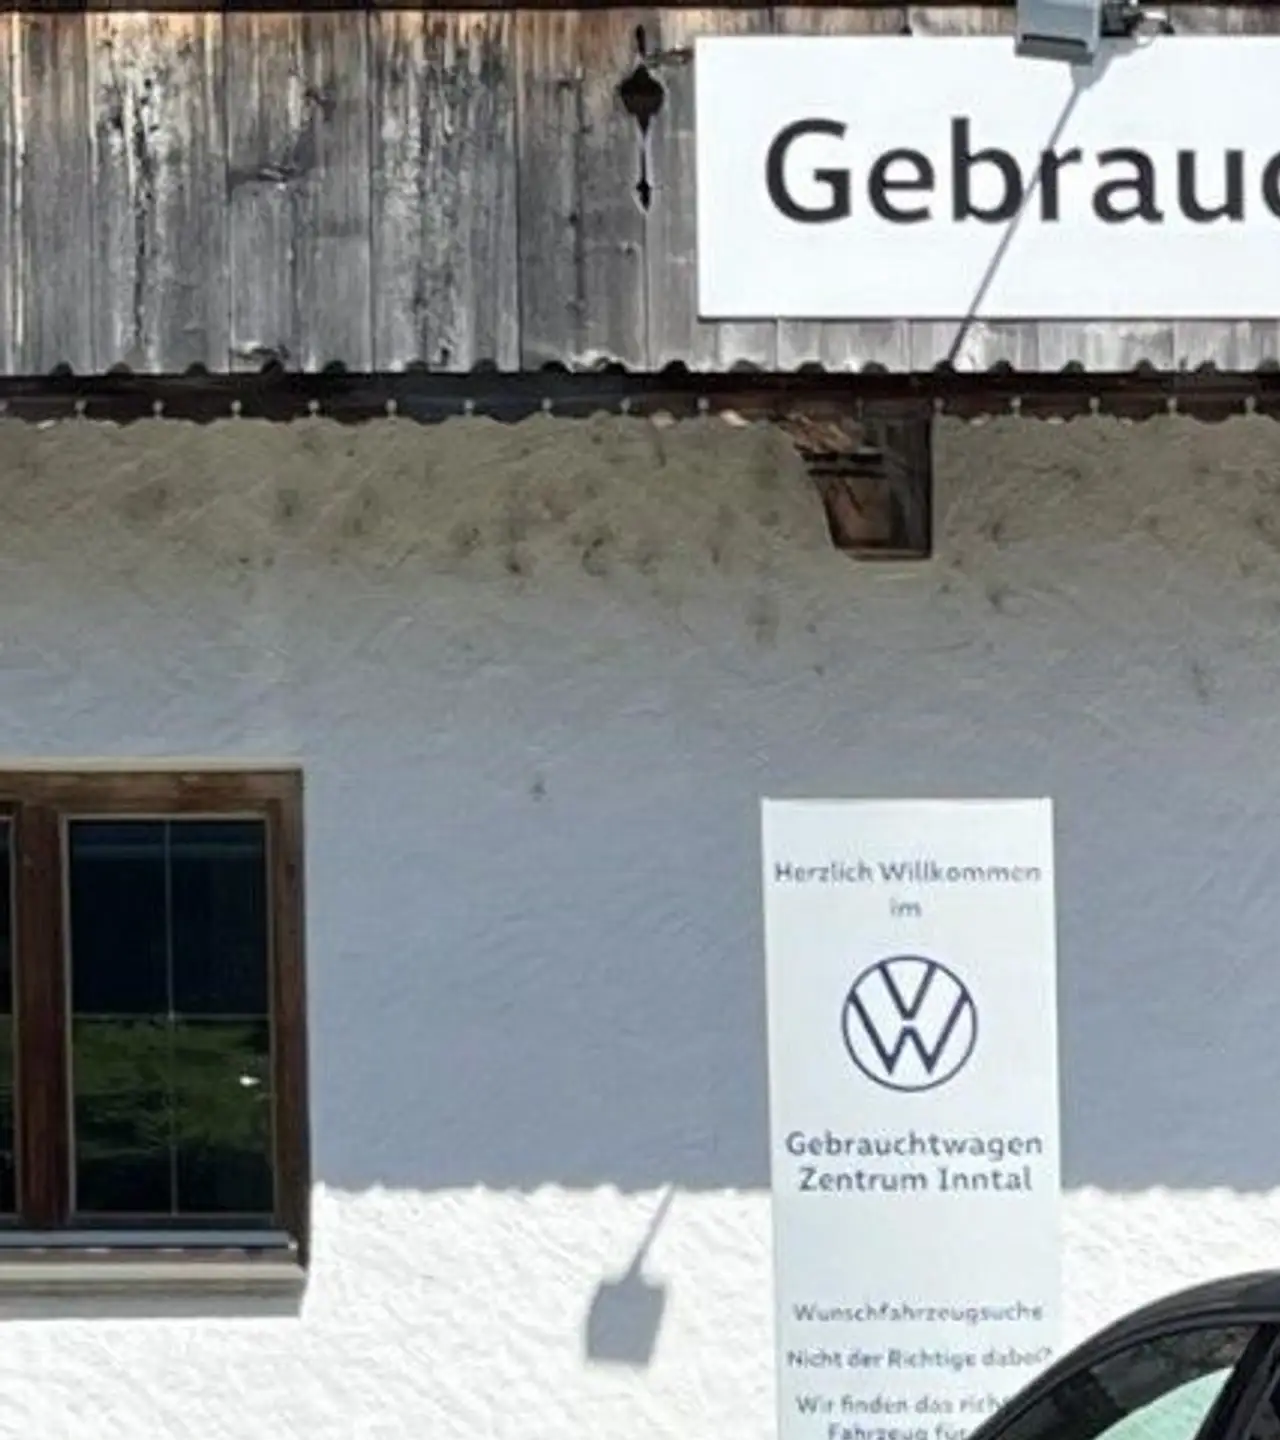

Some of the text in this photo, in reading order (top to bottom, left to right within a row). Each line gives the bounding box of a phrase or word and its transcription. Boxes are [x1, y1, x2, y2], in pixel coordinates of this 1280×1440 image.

[775, 861, 1043, 883] Herzlich Willkommen
[889, 897, 922, 917] im
[786, 1131, 1043, 1162] Gebrauchtwagen
[799, 1166, 1033, 1193] Zentrum Inntal
[792, 1301, 1044, 1326] Wunschfahrzeugsuche
[787, 1350, 842, 1367] Nicht
